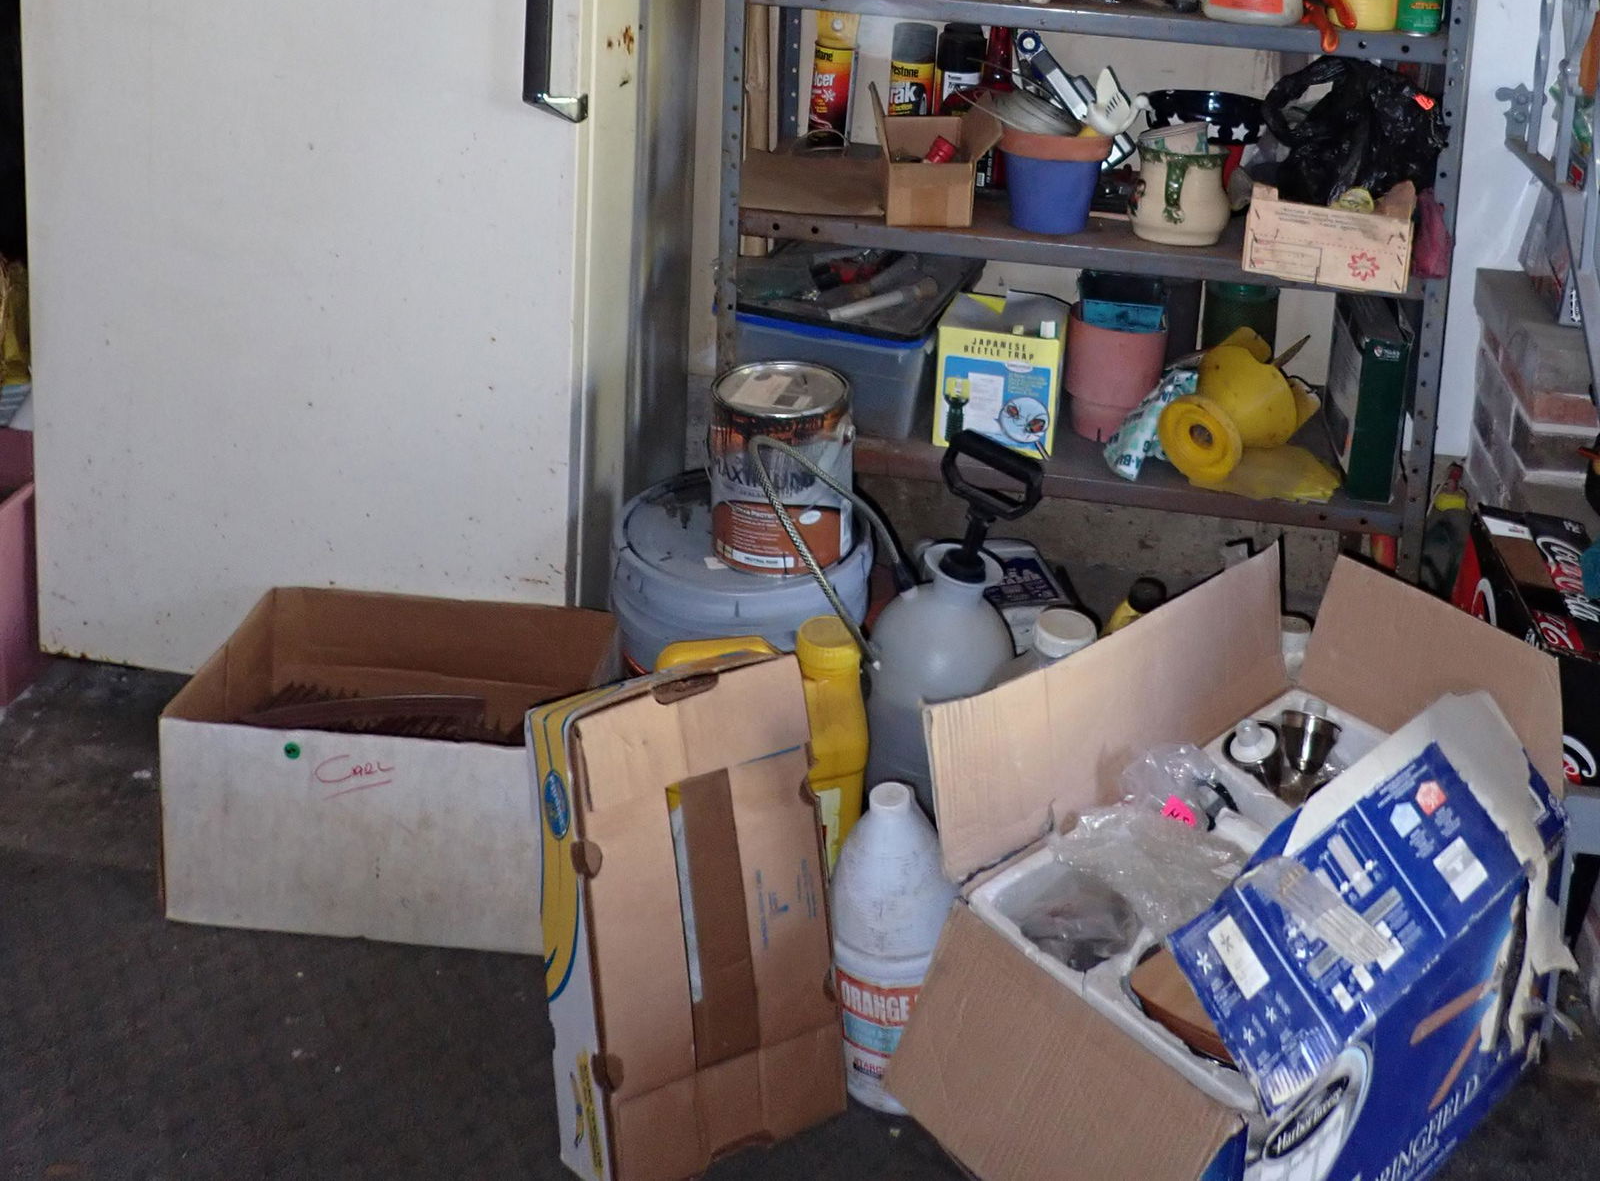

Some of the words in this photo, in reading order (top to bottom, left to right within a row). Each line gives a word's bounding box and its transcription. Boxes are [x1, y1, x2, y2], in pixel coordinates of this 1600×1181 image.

[890, 82, 917, 104] rak
[963, 344, 1001, 357] BEETLE
[1008, 351, 1034, 361] TRAP
[972, 337, 1027, 352] JAPANESE
[840, 980, 909, 1022] ORANGE
